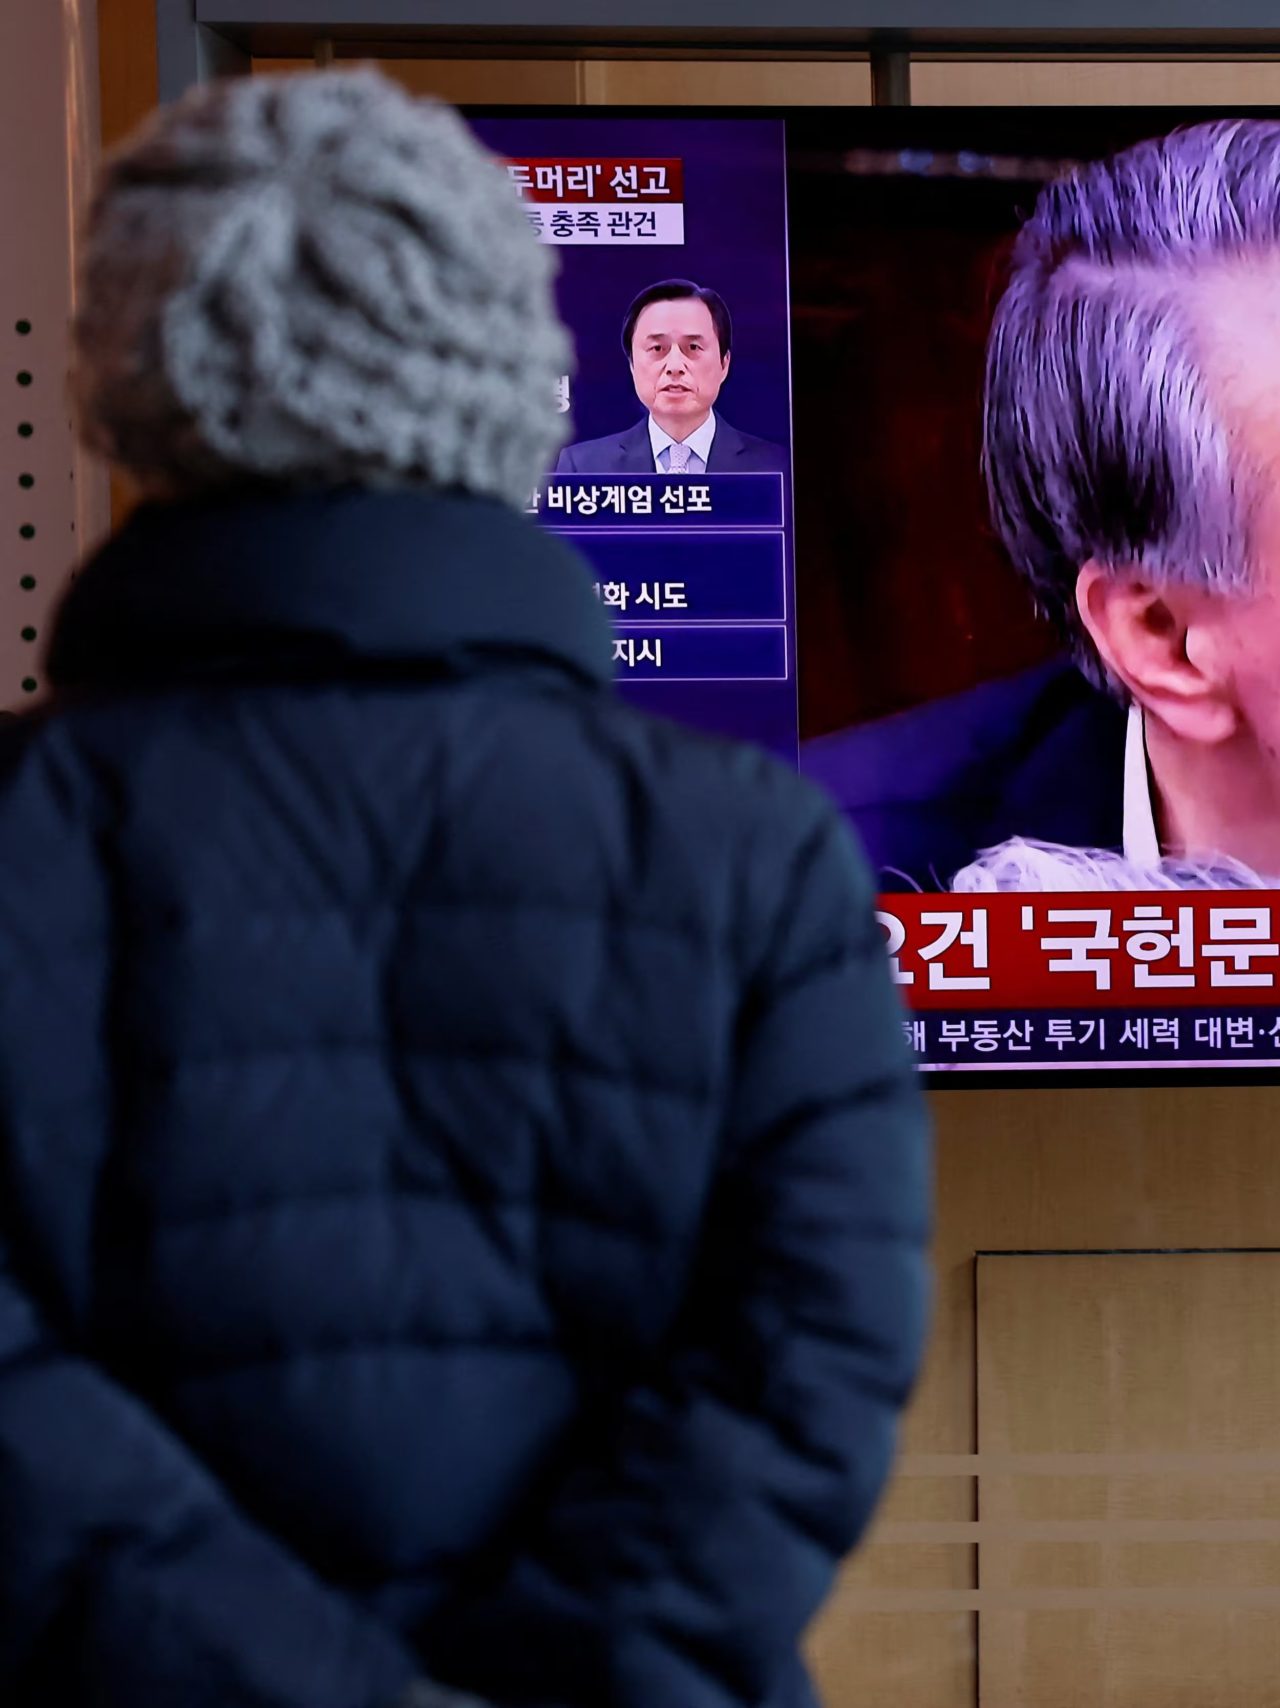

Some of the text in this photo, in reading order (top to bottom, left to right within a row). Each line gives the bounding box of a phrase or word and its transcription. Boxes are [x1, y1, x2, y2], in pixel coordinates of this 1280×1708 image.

[610, 165, 670, 198] 선고
[550, 211, 601, 237] 충족
[607, 211, 657, 237] 관건
[547, 486, 652, 515] 비상계엄
[659, 485, 712, 514] 선포
[635, 582, 688, 611] 시도
[611, 639, 662, 667] 지시
[938, 1019, 1034, 1053] 부동산
[1044, 1018, 1105, 1051] 투기
[1118, 1017, 1180, 1050] 세력
